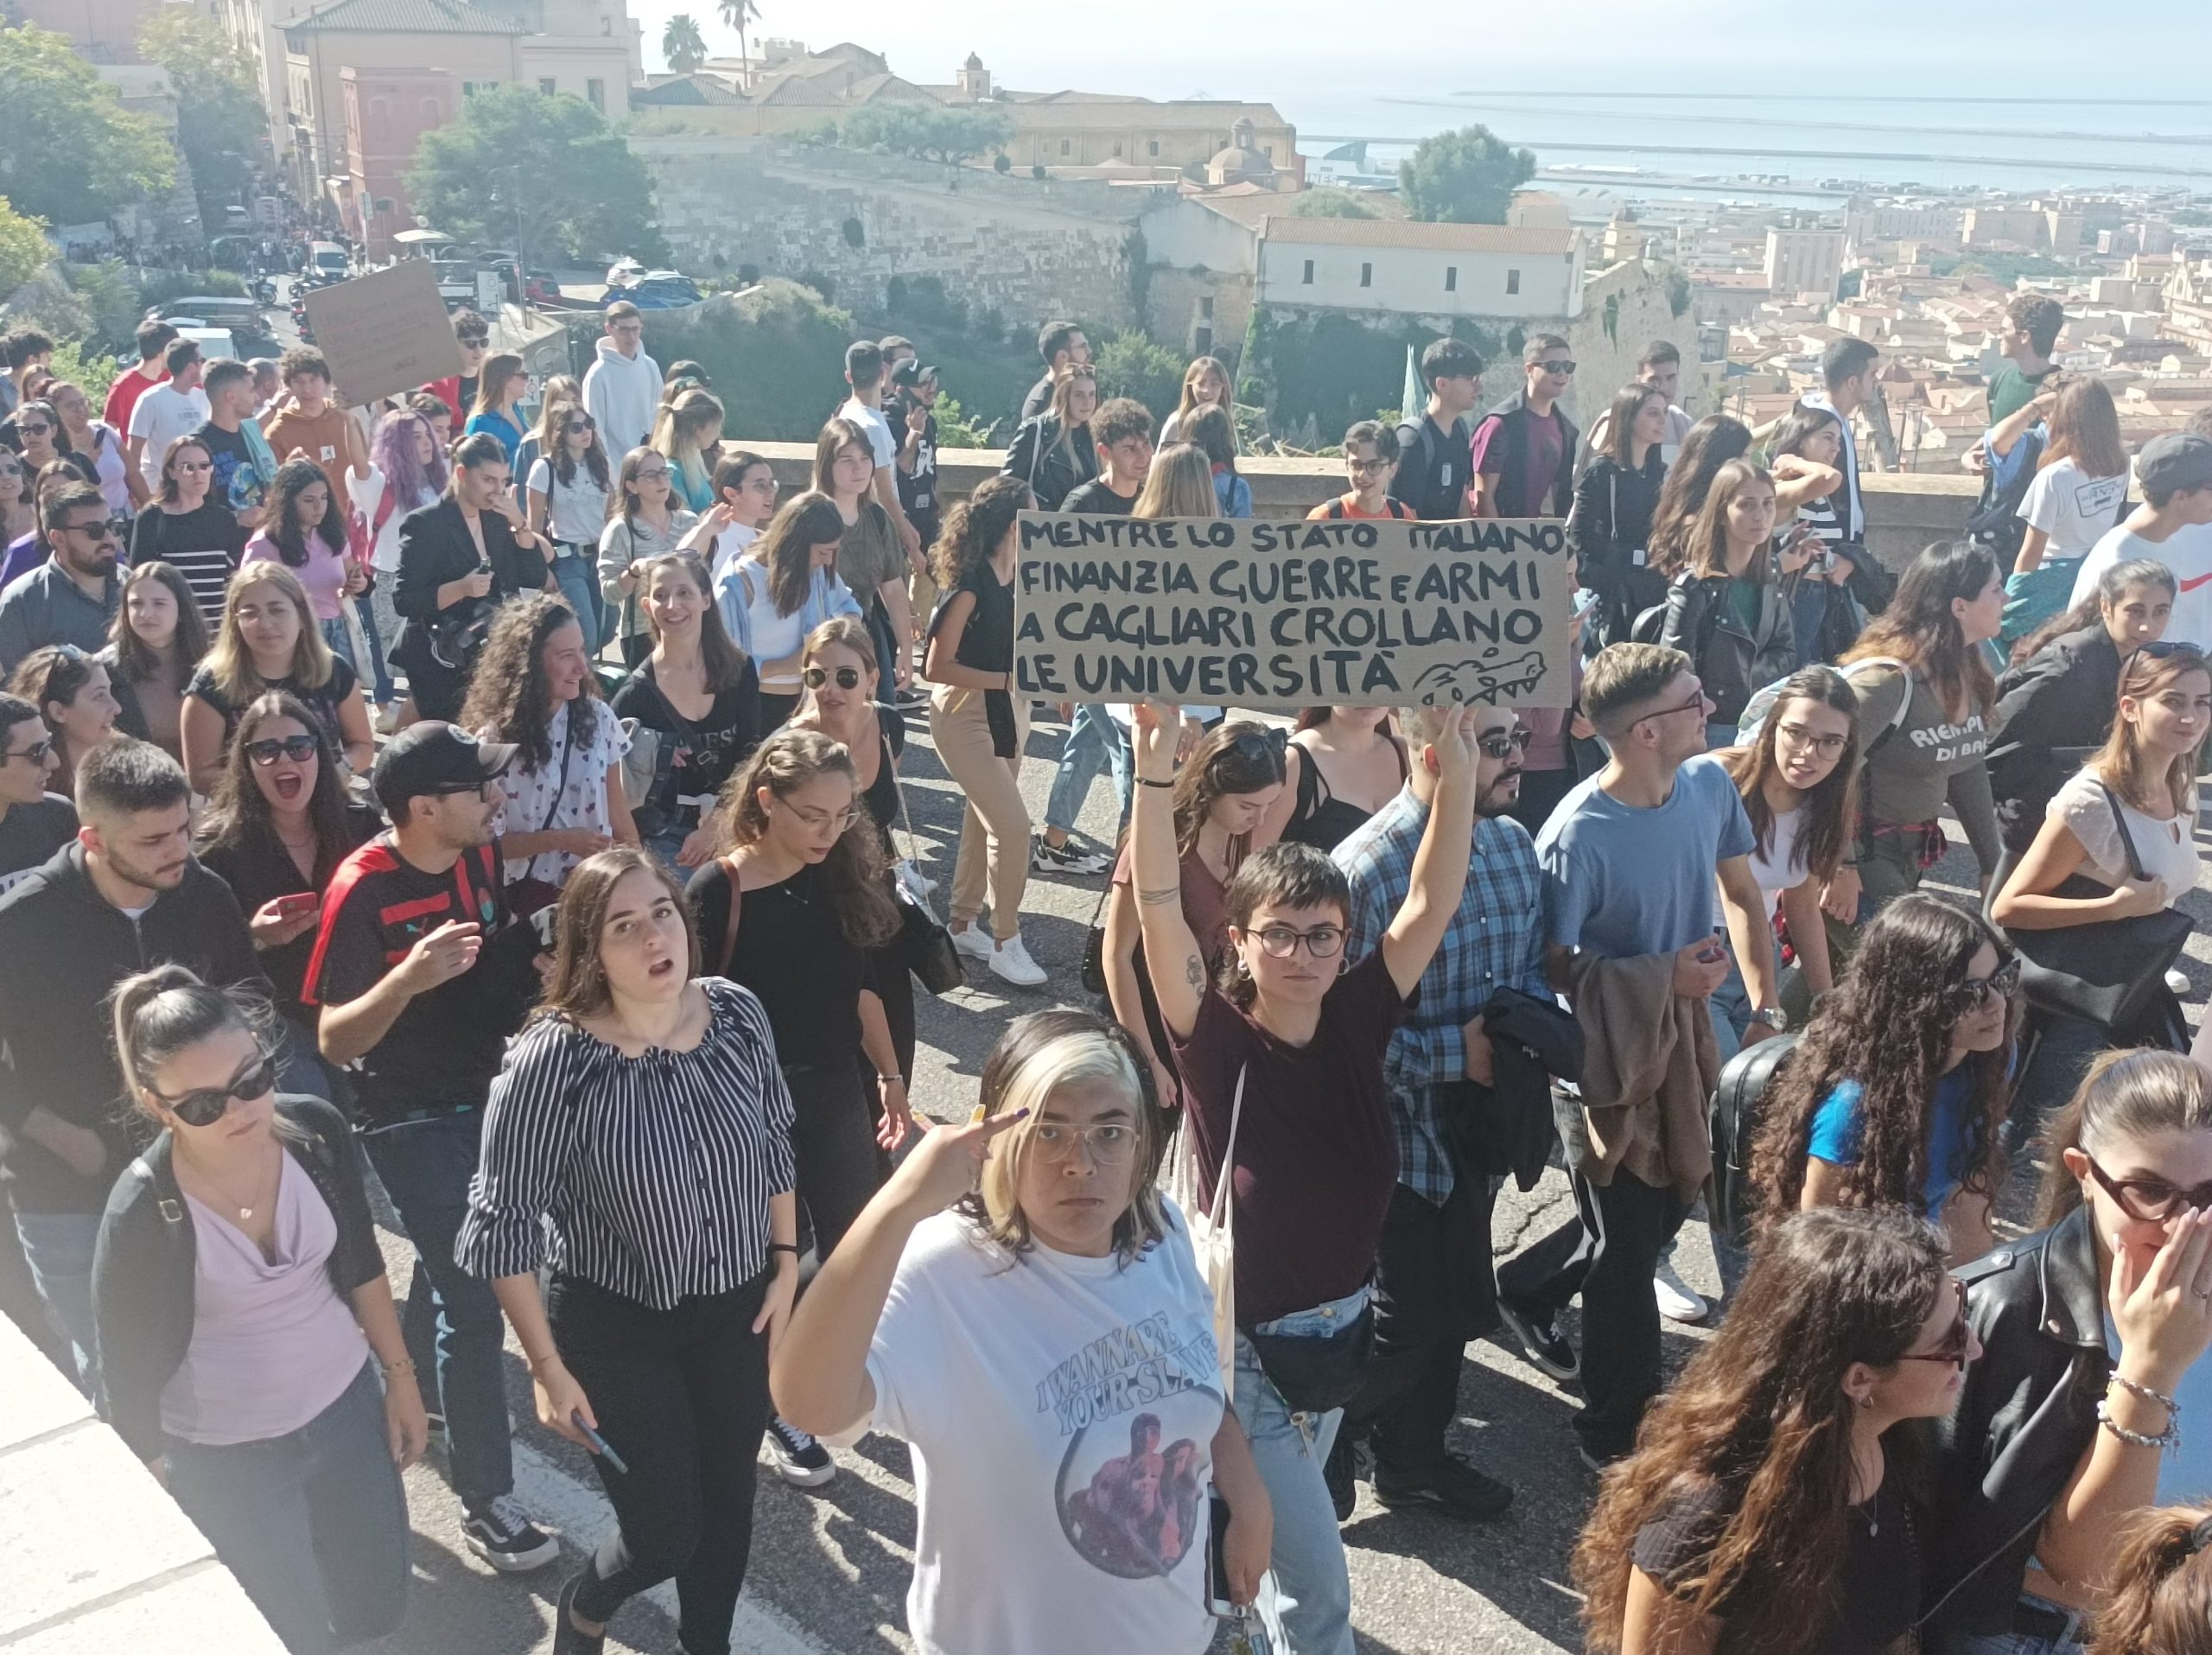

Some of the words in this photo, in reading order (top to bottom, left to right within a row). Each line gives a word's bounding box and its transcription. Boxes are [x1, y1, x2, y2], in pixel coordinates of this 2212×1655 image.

[1020, 519, 1179, 551] MENTRE
[1187, 524, 1236, 548] LO
[1251, 522, 1378, 553] STATO
[1408, 520, 1566, 556] ITALIANO
[1020, 560, 1199, 595] FINANZIA
[1210, 558, 1382, 604] GUERRE
[1414, 559, 1541, 603] ARMI
[1017, 612, 1045, 645] A
[1054, 602, 1256, 652] CAGLIARI
[1270, 606, 1544, 649] CROLLANO
[1018, 653, 1067, 694] LE
[1936, 746, 1957, 762] DI
[1035, 1381, 1049, 1413] I
[1053, 1372, 1135, 1436] YOUR
